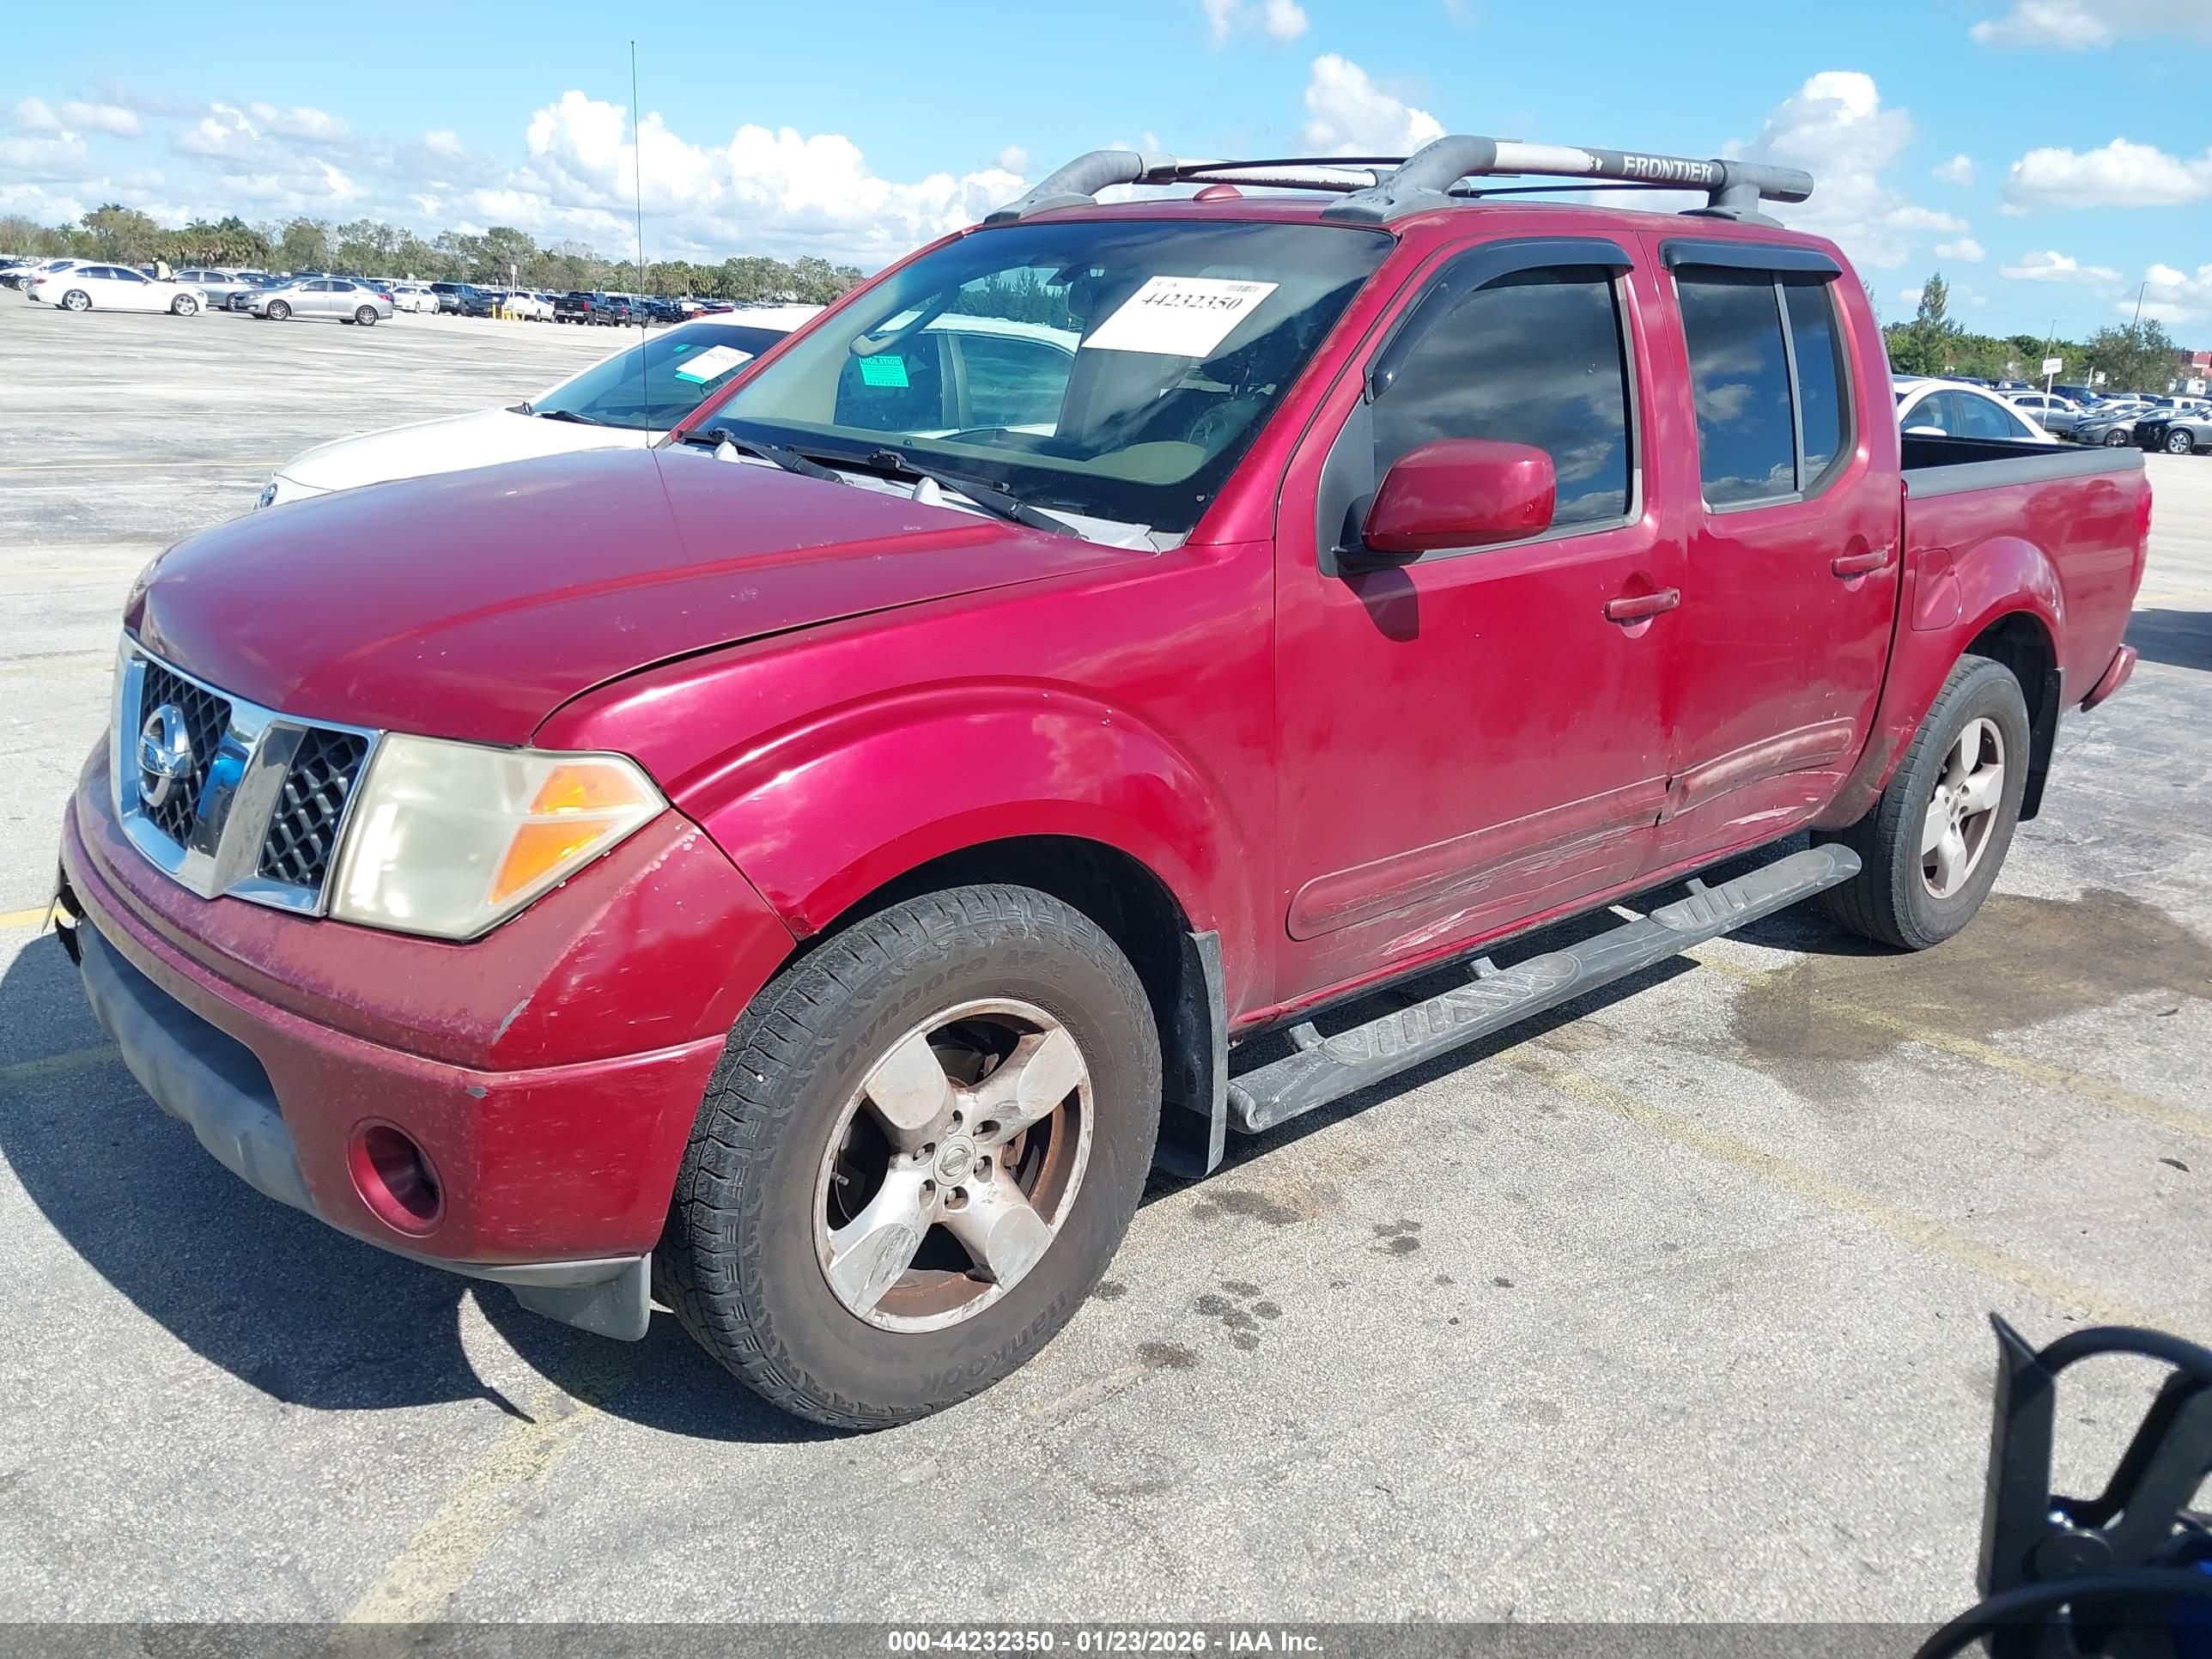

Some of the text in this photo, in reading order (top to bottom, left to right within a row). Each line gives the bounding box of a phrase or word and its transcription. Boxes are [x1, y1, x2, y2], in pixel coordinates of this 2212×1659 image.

[1621, 155, 1713, 183] FRONTIER
[1141, 293, 1243, 310] 44232350
[861, 357, 902, 366] VIOLATION
